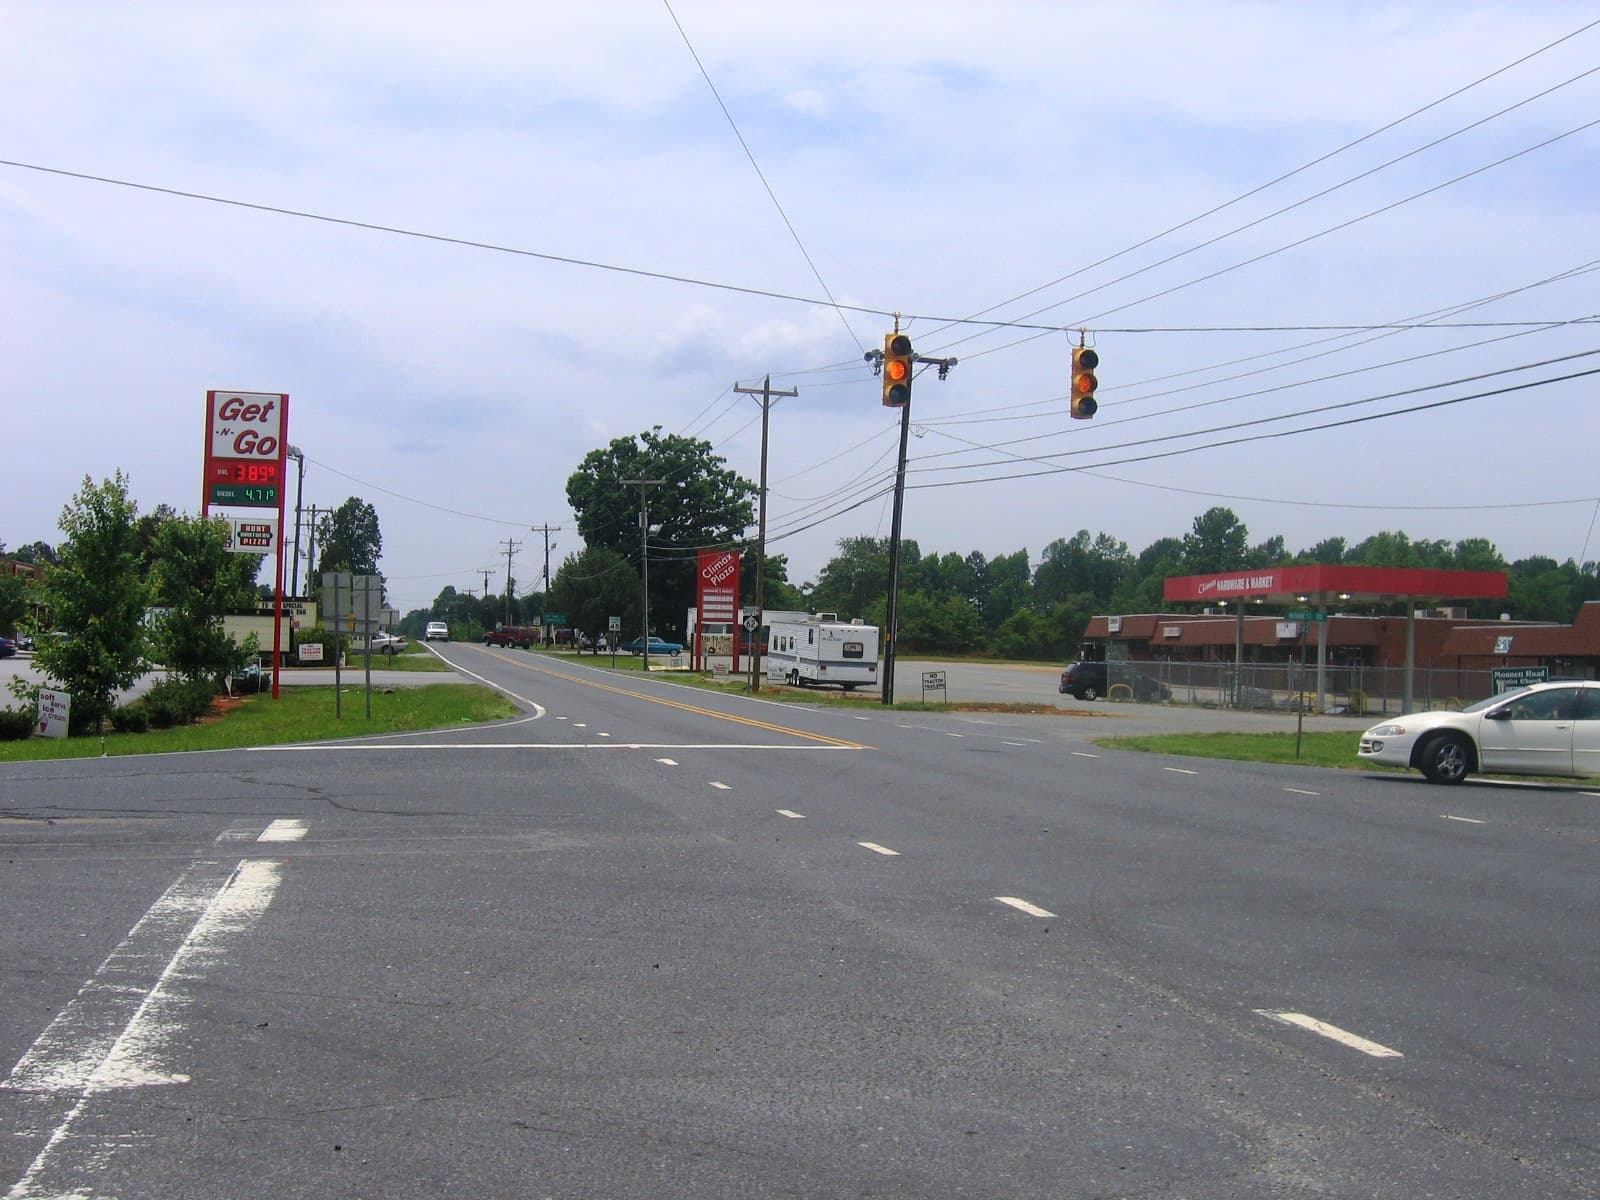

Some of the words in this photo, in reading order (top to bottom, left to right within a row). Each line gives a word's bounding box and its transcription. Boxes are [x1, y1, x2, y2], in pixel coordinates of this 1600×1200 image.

[219, 397, 274, 422] Get
[233, 429, 277, 455] Go
[702, 553, 733, 579] Climax
[710, 565, 735, 586] Plaza
[746, 619, 756, 628] 62
[1525, 669, 1545, 677] Road
